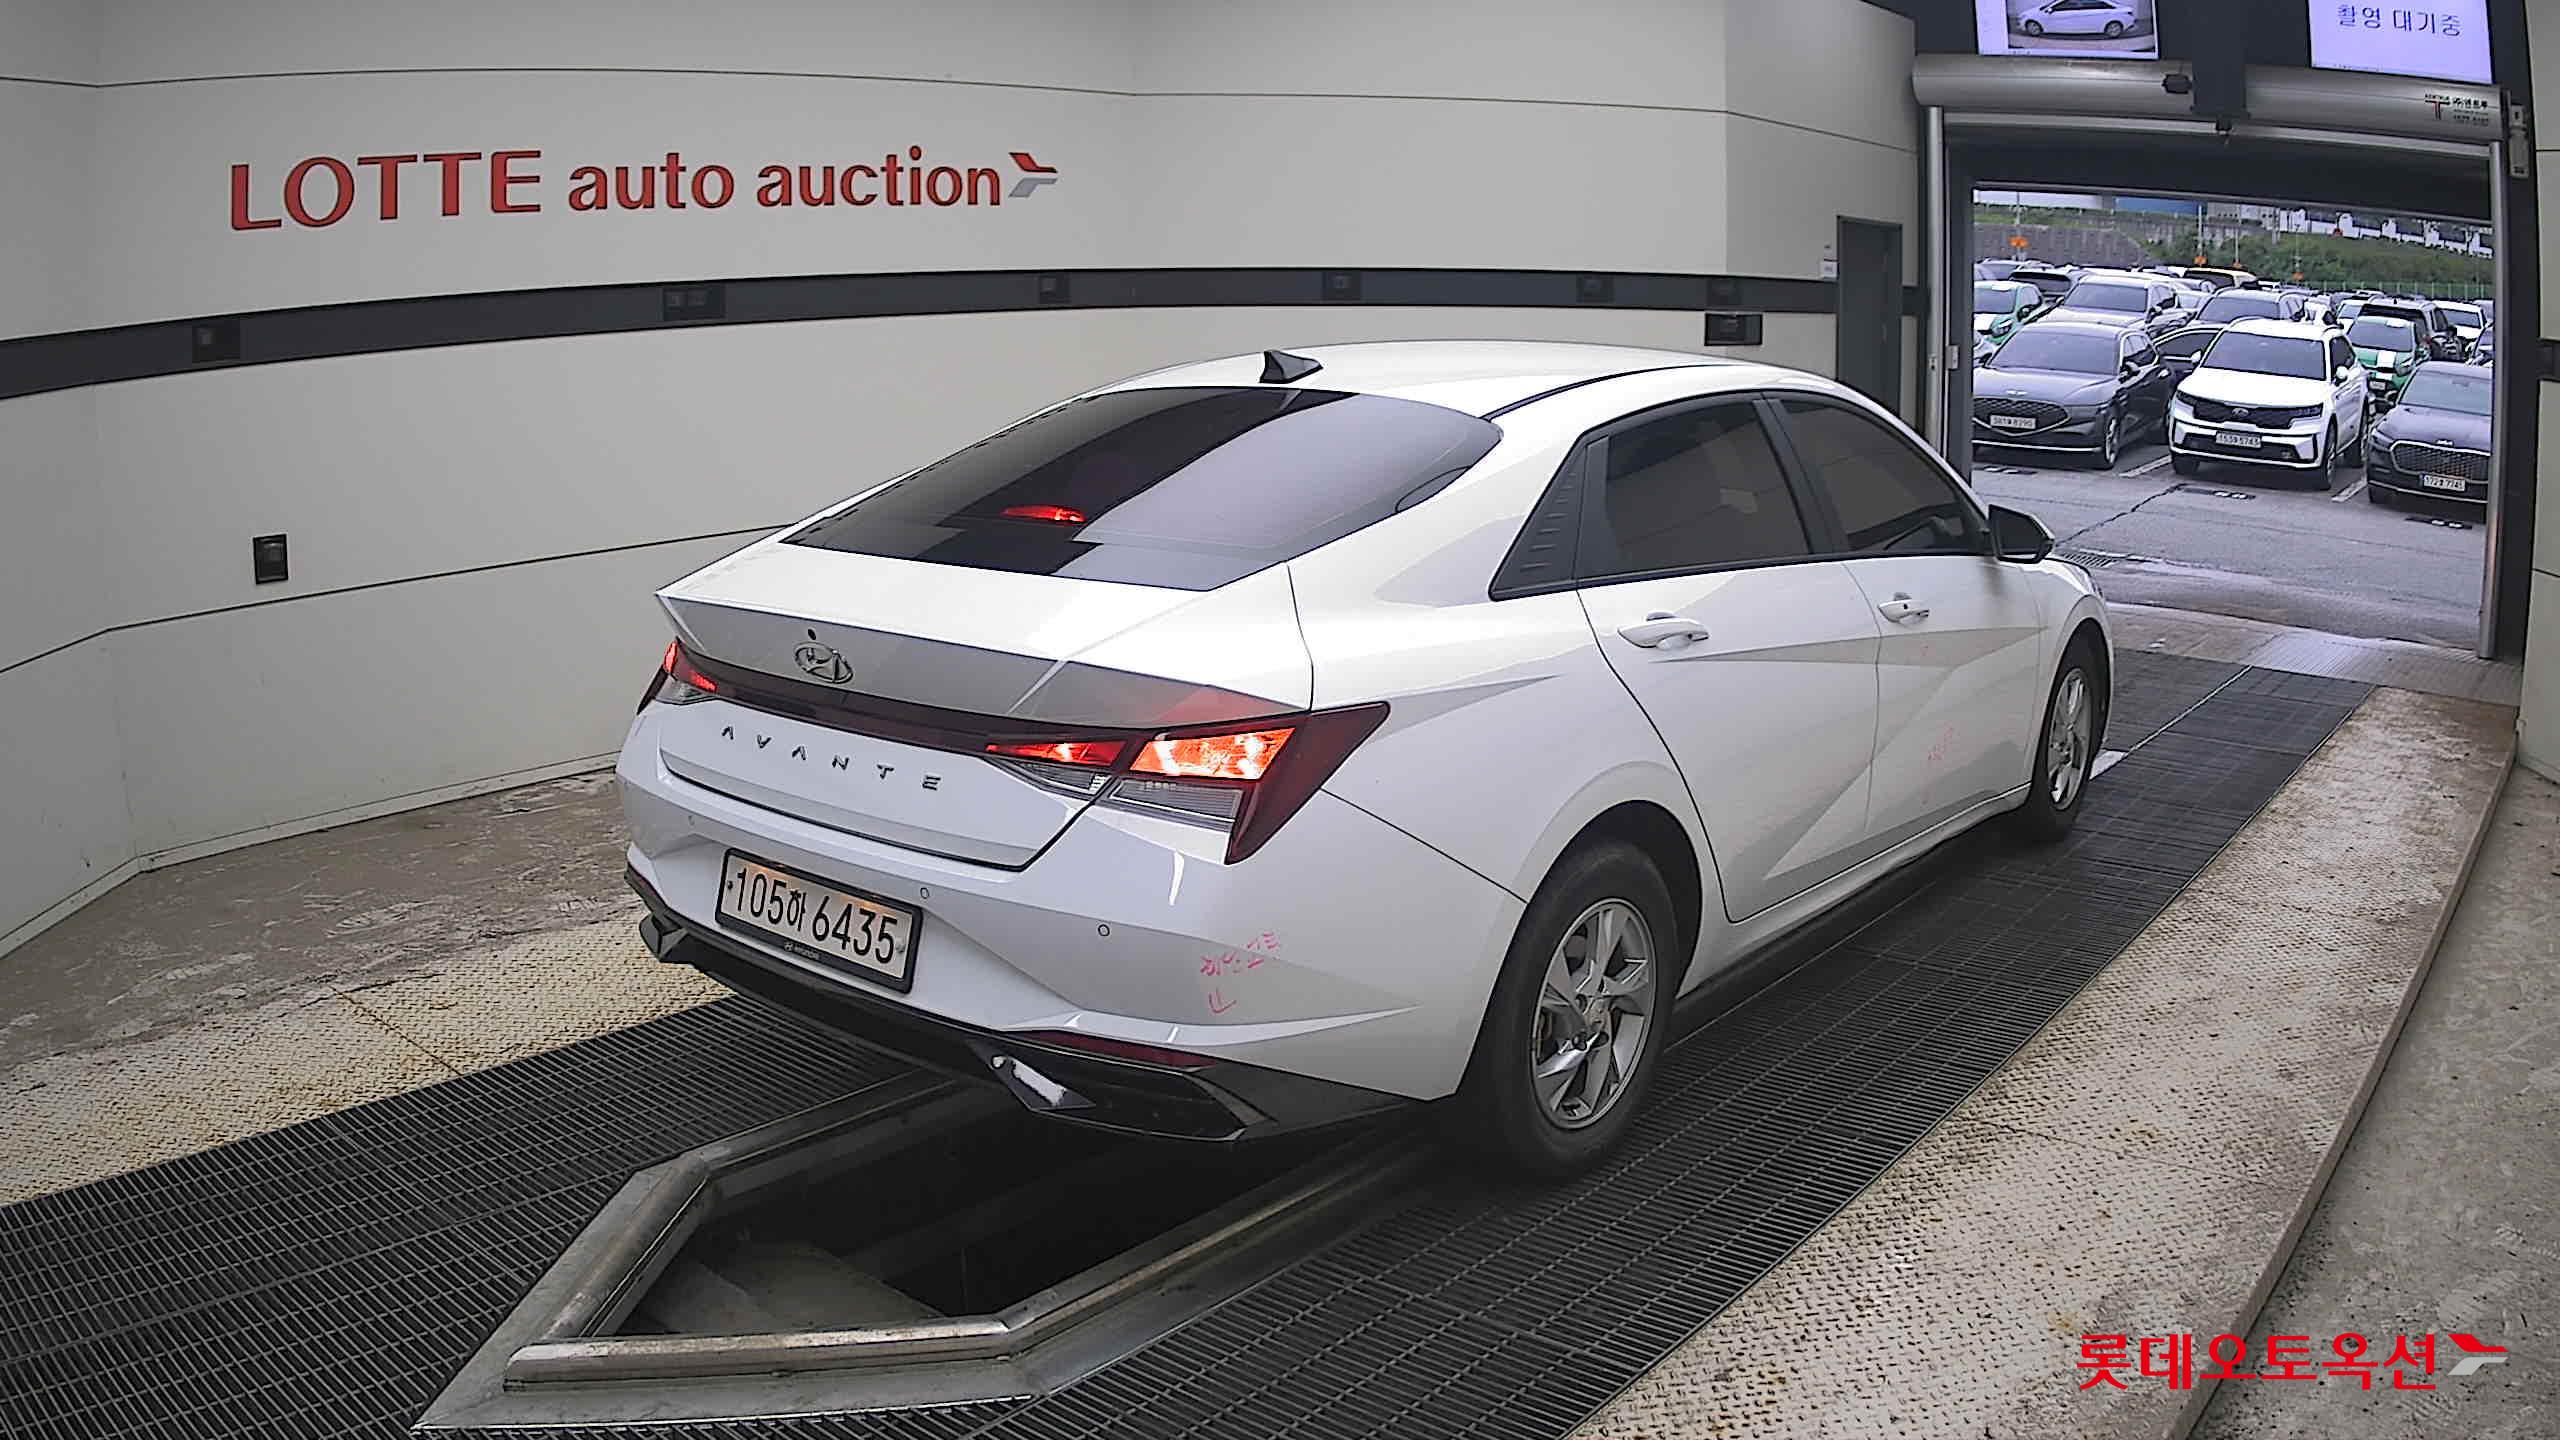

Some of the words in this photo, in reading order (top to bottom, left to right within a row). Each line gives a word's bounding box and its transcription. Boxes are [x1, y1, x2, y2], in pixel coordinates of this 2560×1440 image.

[2338, 5, 2381, 29] 촬영
[2393, 9, 2460, 37] 대기중
[231, 150, 541, 231] LOTTE
[567, 151, 735, 209] auto
[756, 145, 1001, 207] auction
[721, 726, 941, 790] AVANTE
[812, 895, 898, 964] 6435
